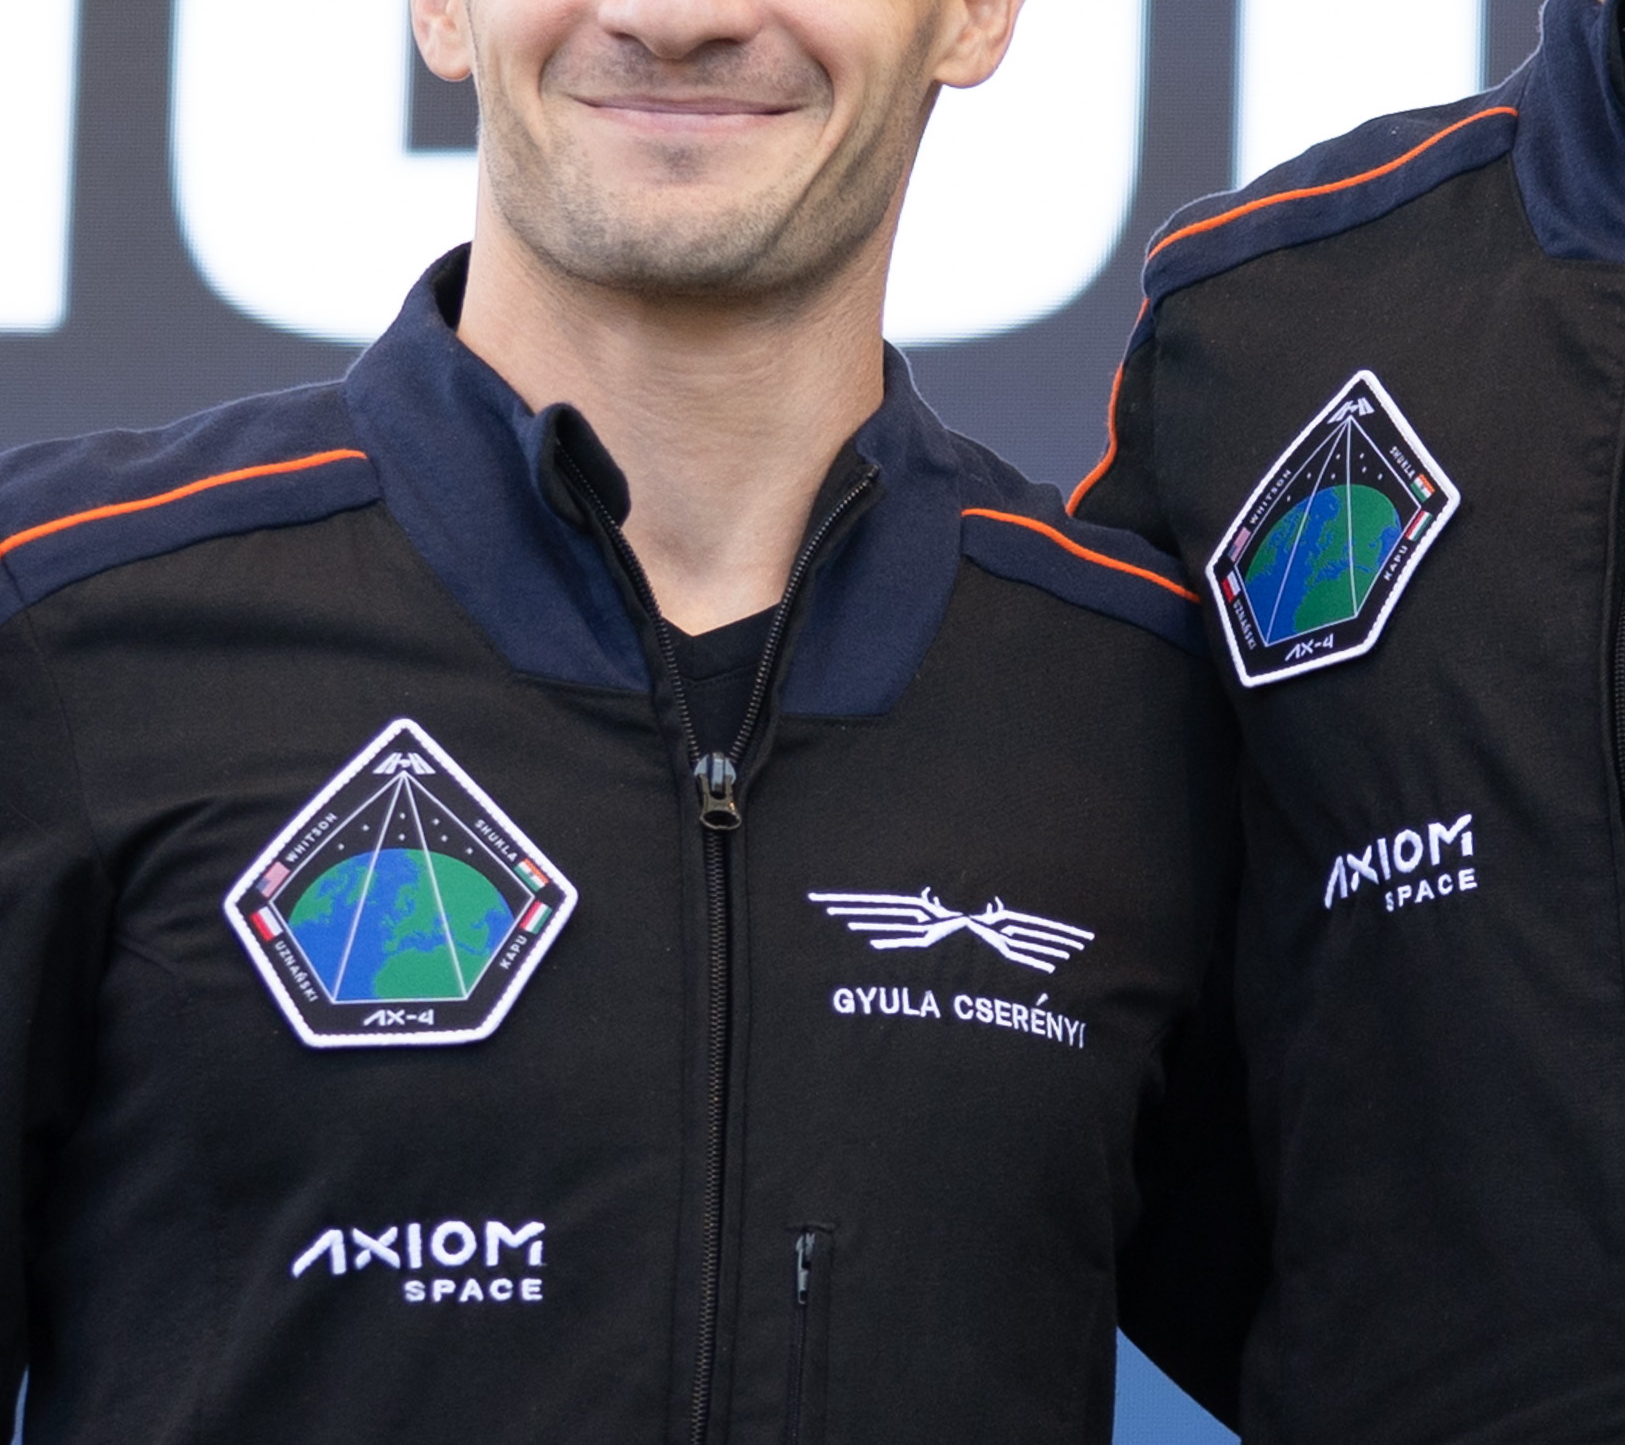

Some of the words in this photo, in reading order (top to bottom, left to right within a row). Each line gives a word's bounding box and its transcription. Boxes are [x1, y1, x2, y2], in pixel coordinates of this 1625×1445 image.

[1249, 468, 1292, 526] WHITSON
[1383, 544, 1408, 582] KAPU
[1284, 633, 1335, 662] AX-4
[285, 812, 338, 864] WHITSON
[475, 818, 518, 863] SHUKLA
[1324, 813, 1473, 910] AXIOM
[1384, 867, 1478, 913] SPACE
[274, 940, 319, 1003] UZNAŃSKI
[499, 934, 528, 970] KAPU
[362, 1008, 436, 1027] AX-4
[832, 986, 941, 1019] GYULA
[953, 992, 1087, 1049] CSERÉNYI
[292, 1220, 546, 1278] AXIOM
[403, 1277, 544, 1303] SPACE
